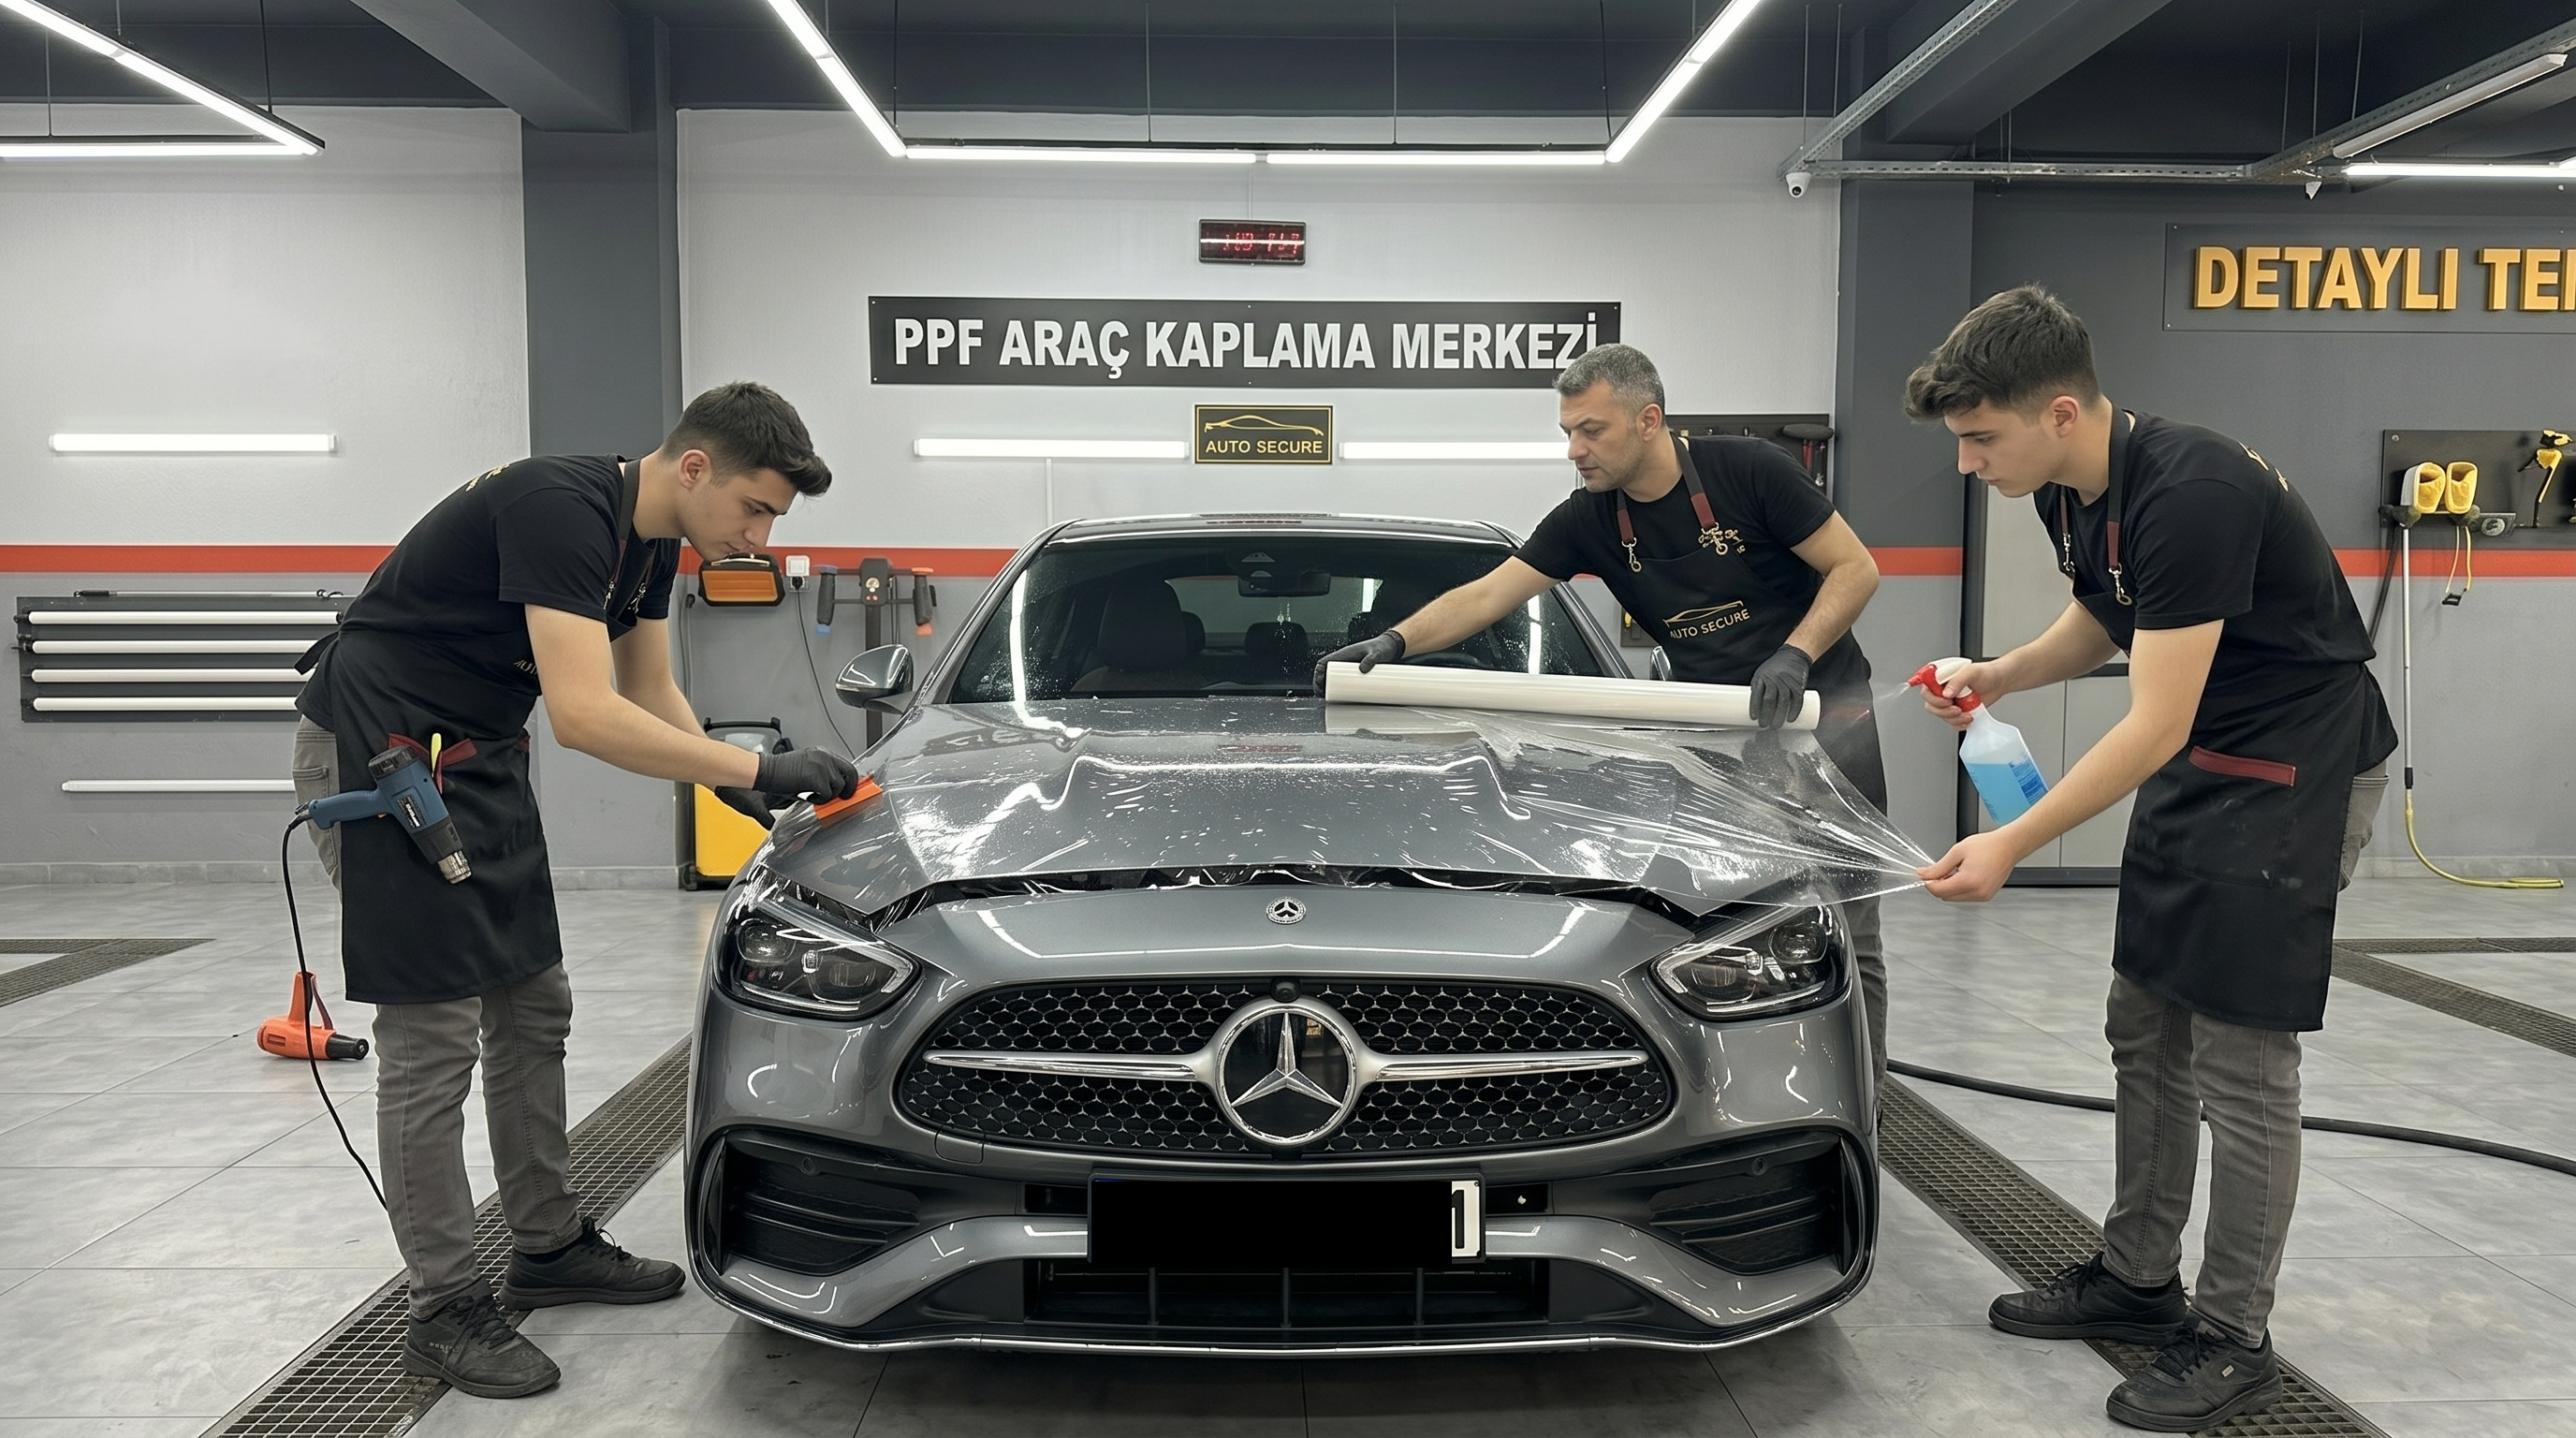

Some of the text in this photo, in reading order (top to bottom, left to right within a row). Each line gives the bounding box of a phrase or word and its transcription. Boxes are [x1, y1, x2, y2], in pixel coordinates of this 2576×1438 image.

[2194, 245, 2459, 310] DETAYLI
[895, 312, 1597, 379] PPF ARAÇ KAPLAMA MERKEZİ
[1205, 440, 1323, 453] AUTO SECURE
[1669, 609, 1750, 639] AUTO SECURE
